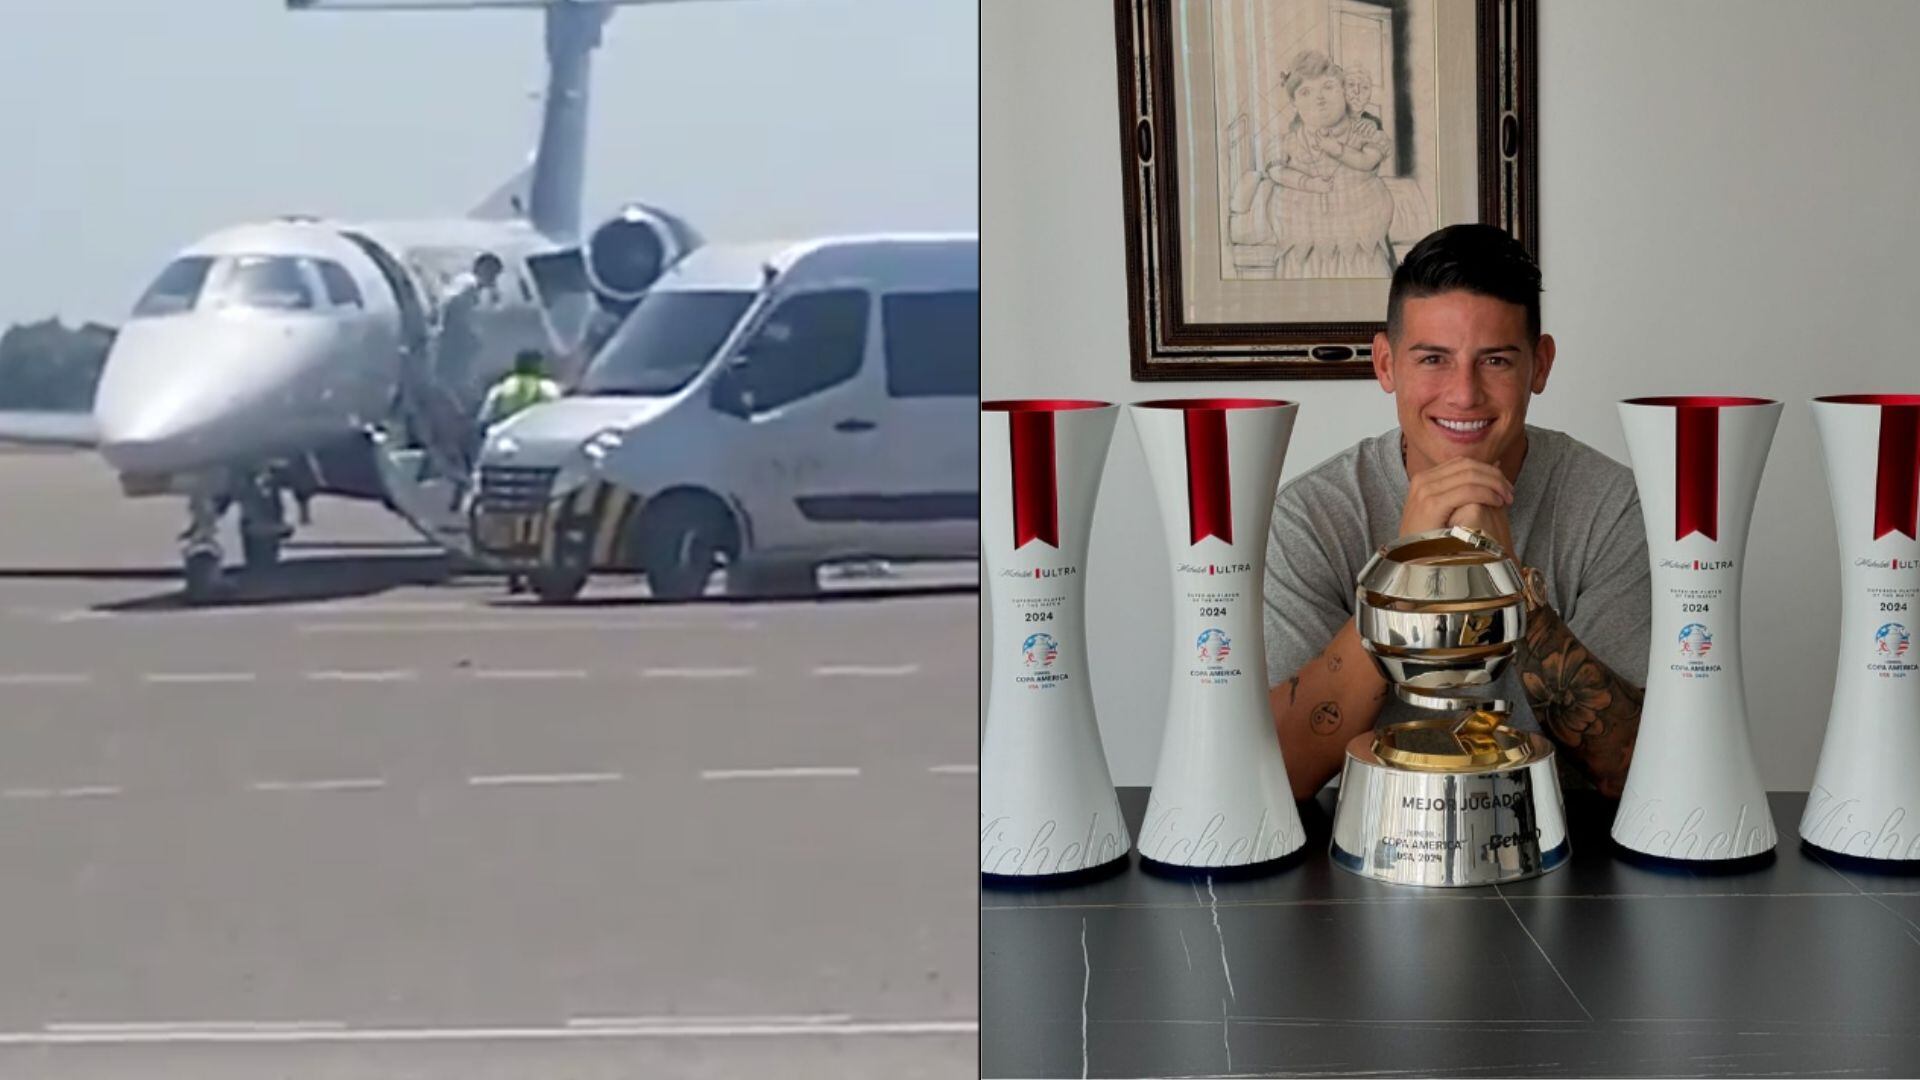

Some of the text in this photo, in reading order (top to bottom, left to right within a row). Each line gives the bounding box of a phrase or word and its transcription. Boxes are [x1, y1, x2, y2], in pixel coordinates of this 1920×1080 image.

[1217, 563, 1251, 574] ULTRA
[1700, 560, 1734, 570] ULTRA
[1042, 567, 1076, 577] ULTRA
[1682, 604, 1709, 612] 2024
[1880, 602, 1907, 611] 2024
[1025, 612, 1053, 622] 2024
[1200, 607, 1226, 617] 2024
[1037, 674, 1068, 682] AMERICA
[1402, 792, 1526, 811] MEJOR JUGADO
[1382, 836, 1408, 848] COPA
[1412, 840, 1462, 850] AMERICA
[1397, 852, 1442, 862] USA 2024
